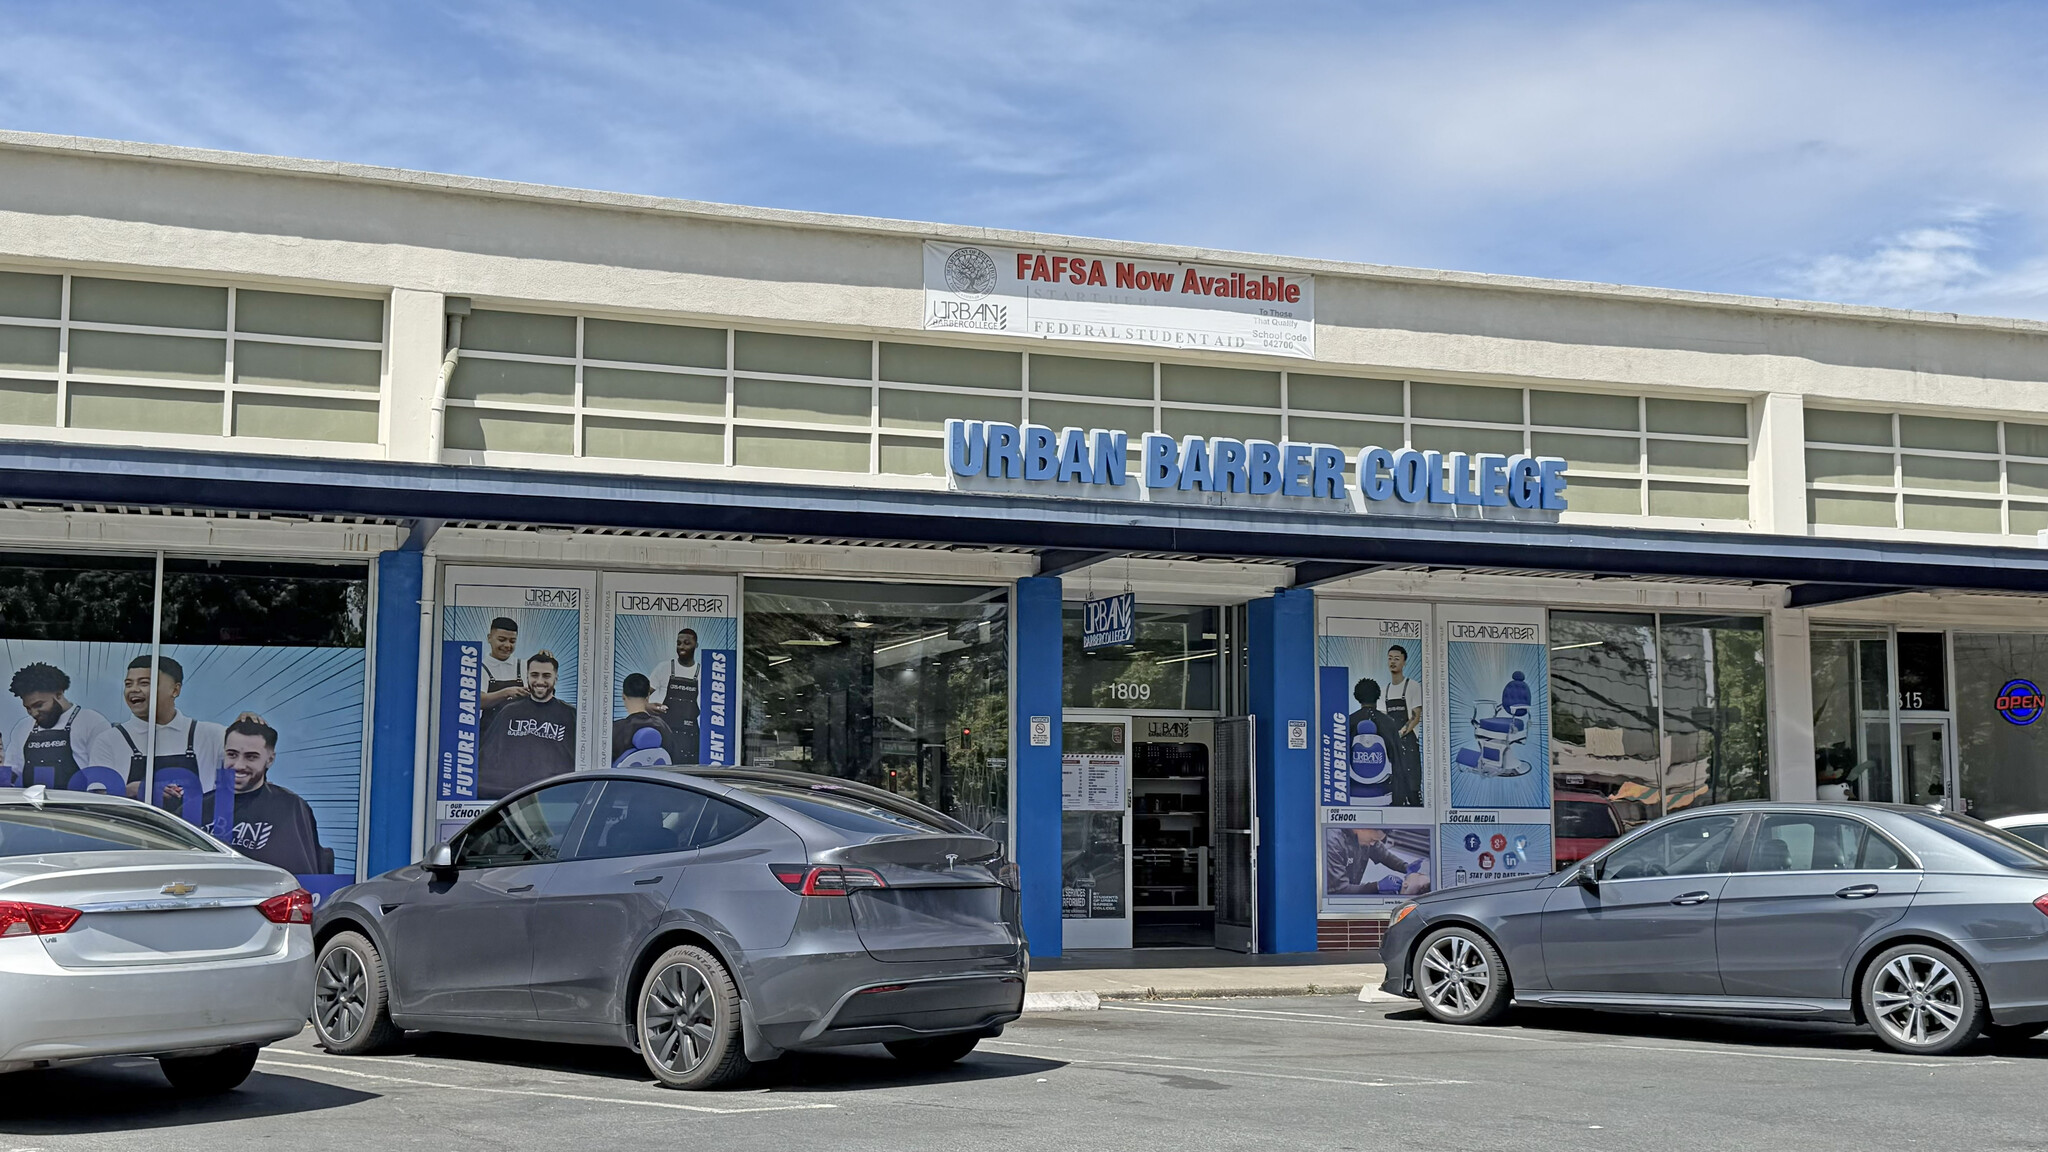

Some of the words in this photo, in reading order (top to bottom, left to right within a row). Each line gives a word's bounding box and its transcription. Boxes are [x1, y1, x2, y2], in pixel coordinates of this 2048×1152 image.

[1017, 253, 1107, 287] FAFSA
[1116, 262, 1175, 293] Now
[1181, 268, 1301, 303] Available
[934, 301, 999, 321] URBAN
[1259, 308, 1268, 316] To
[1270, 309, 1293, 318] Those
[932, 319, 998, 331] BARBERCOLLEGE
[1254, 316, 1270, 325] That
[1034, 321, 1121, 339] FEDERAL
[1125, 327, 1210, 346] STUDENT
[1214, 334, 1245, 348] AID
[1252, 329, 1283, 340] School
[1285, 332, 1308, 342] Code
[945, 418, 1127, 485] URBAN
[1142, 432, 1346, 499] BARBER
[1358, 445, 1567, 511] COLLEGE
[524, 589, 571, 602] URBAN
[621, 596, 723, 613] URBANBARBER
[1083, 595, 1126, 634] URBAN
[1379, 621, 1415, 633] URBAN
[1452, 625, 1534, 640] URBANBARBER
[1083, 628, 1126, 648] BARBERCOLLEGE
[458, 645, 478, 726] BARBERS
[711, 651, 727, 727] BARBERS
[1109, 683, 1151, 700] 1809
[1996, 695, 2046, 710] OPEN
[508, 719, 558, 736] URBAN
[1323, 733, 1331, 745] OF
[443, 752, 453, 779] BUILD
[456, 730, 476, 797] FUTURE
[1323, 747, 1331, 785] BUSINESS
[1333, 712, 1347, 803] BARBERING
[442, 782, 452, 796] WE
[1323, 787, 1331, 803] THE
[450, 809, 484, 818] SCHOO
[1330, 813, 1357, 822] SCHOOL
[1449, 814, 1472, 823] SOCIAL
[1474, 815, 1496, 823] MEDIA
